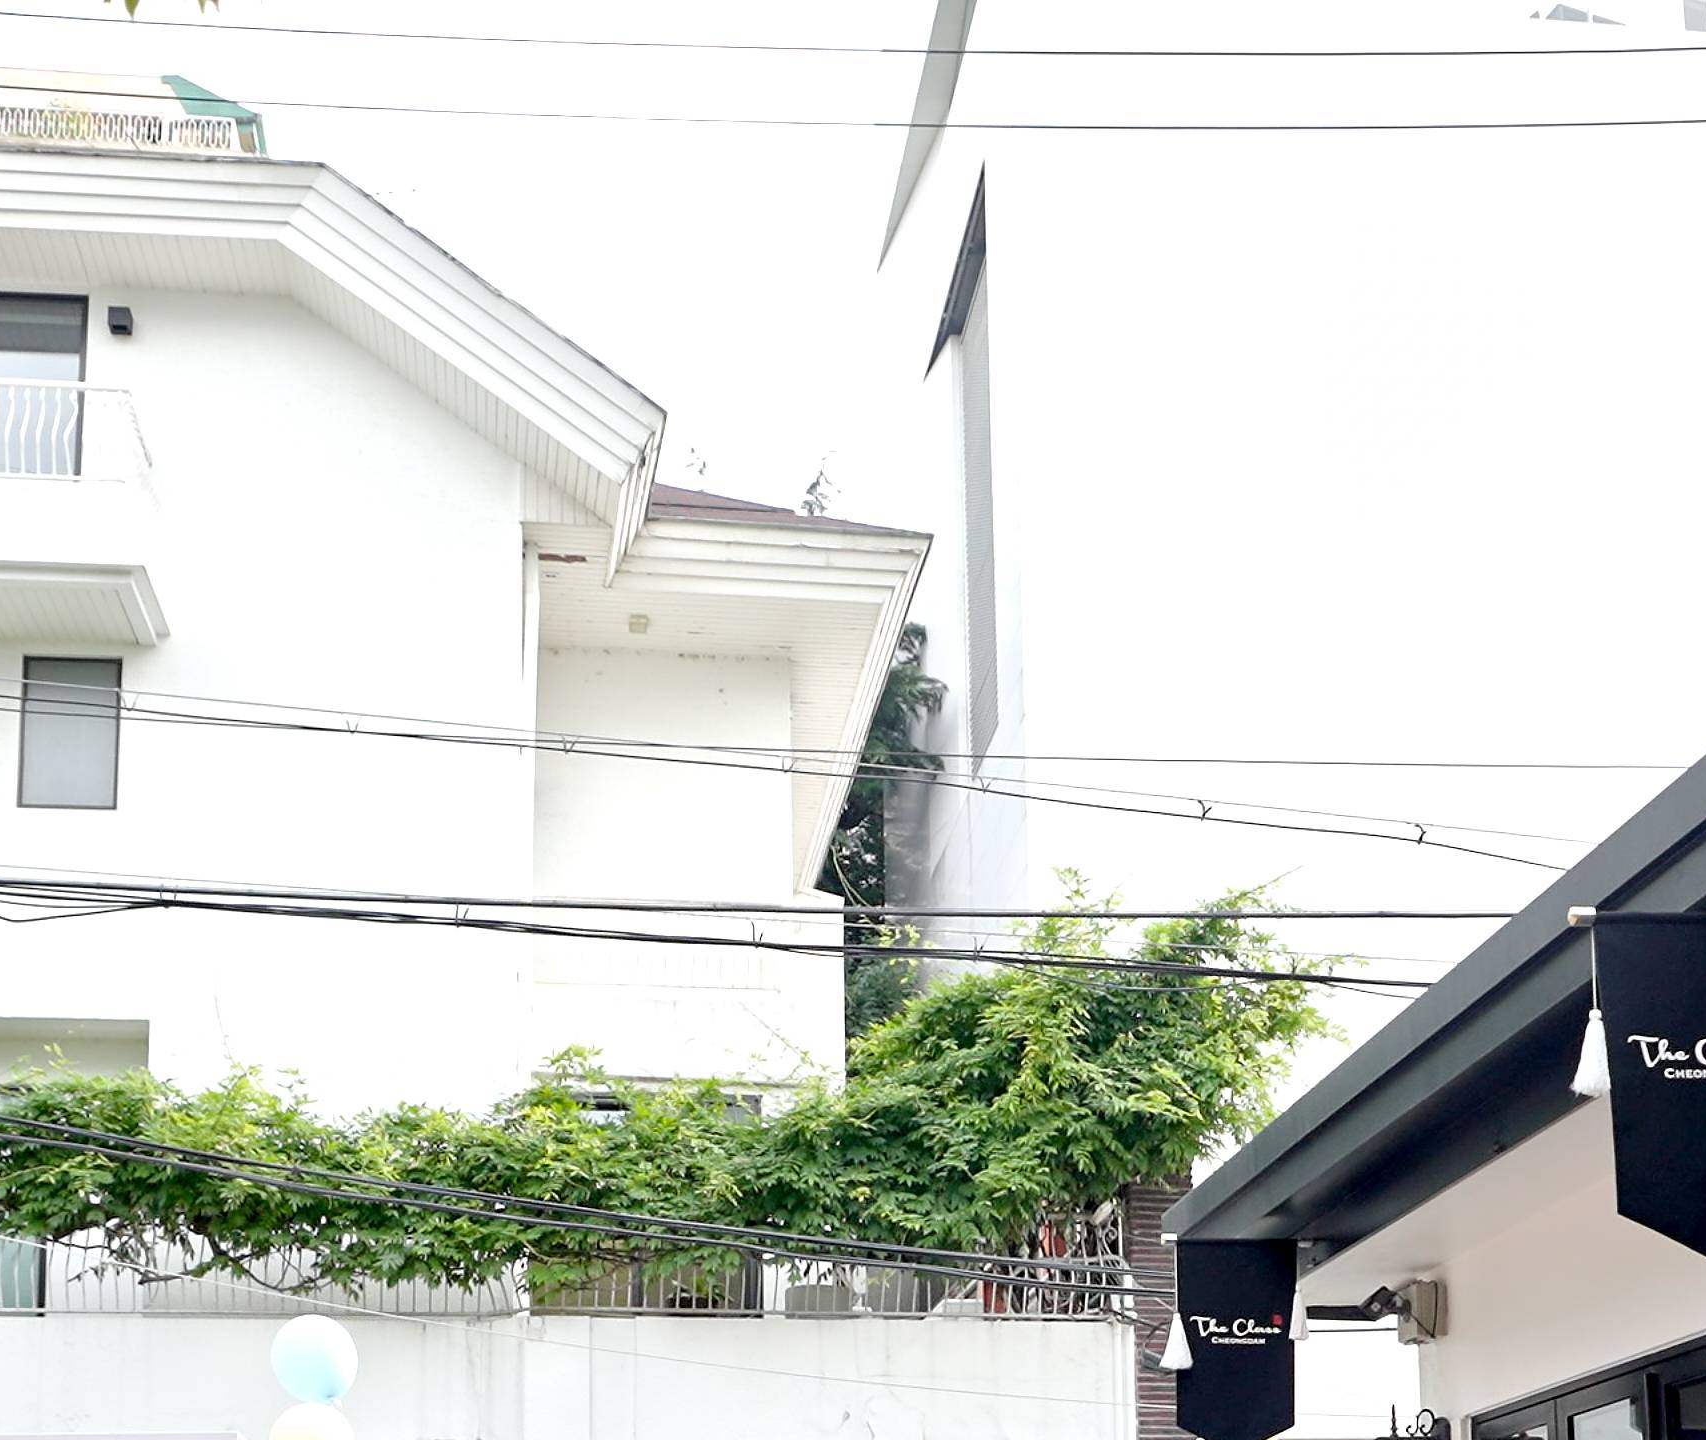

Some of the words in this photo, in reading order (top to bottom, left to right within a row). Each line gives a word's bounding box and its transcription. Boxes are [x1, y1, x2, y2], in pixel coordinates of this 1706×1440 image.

[1627, 1035, 1690, 1067] The
[1189, 1315, 1229, 1337] The
[1232, 1318, 1282, 1336] Class
